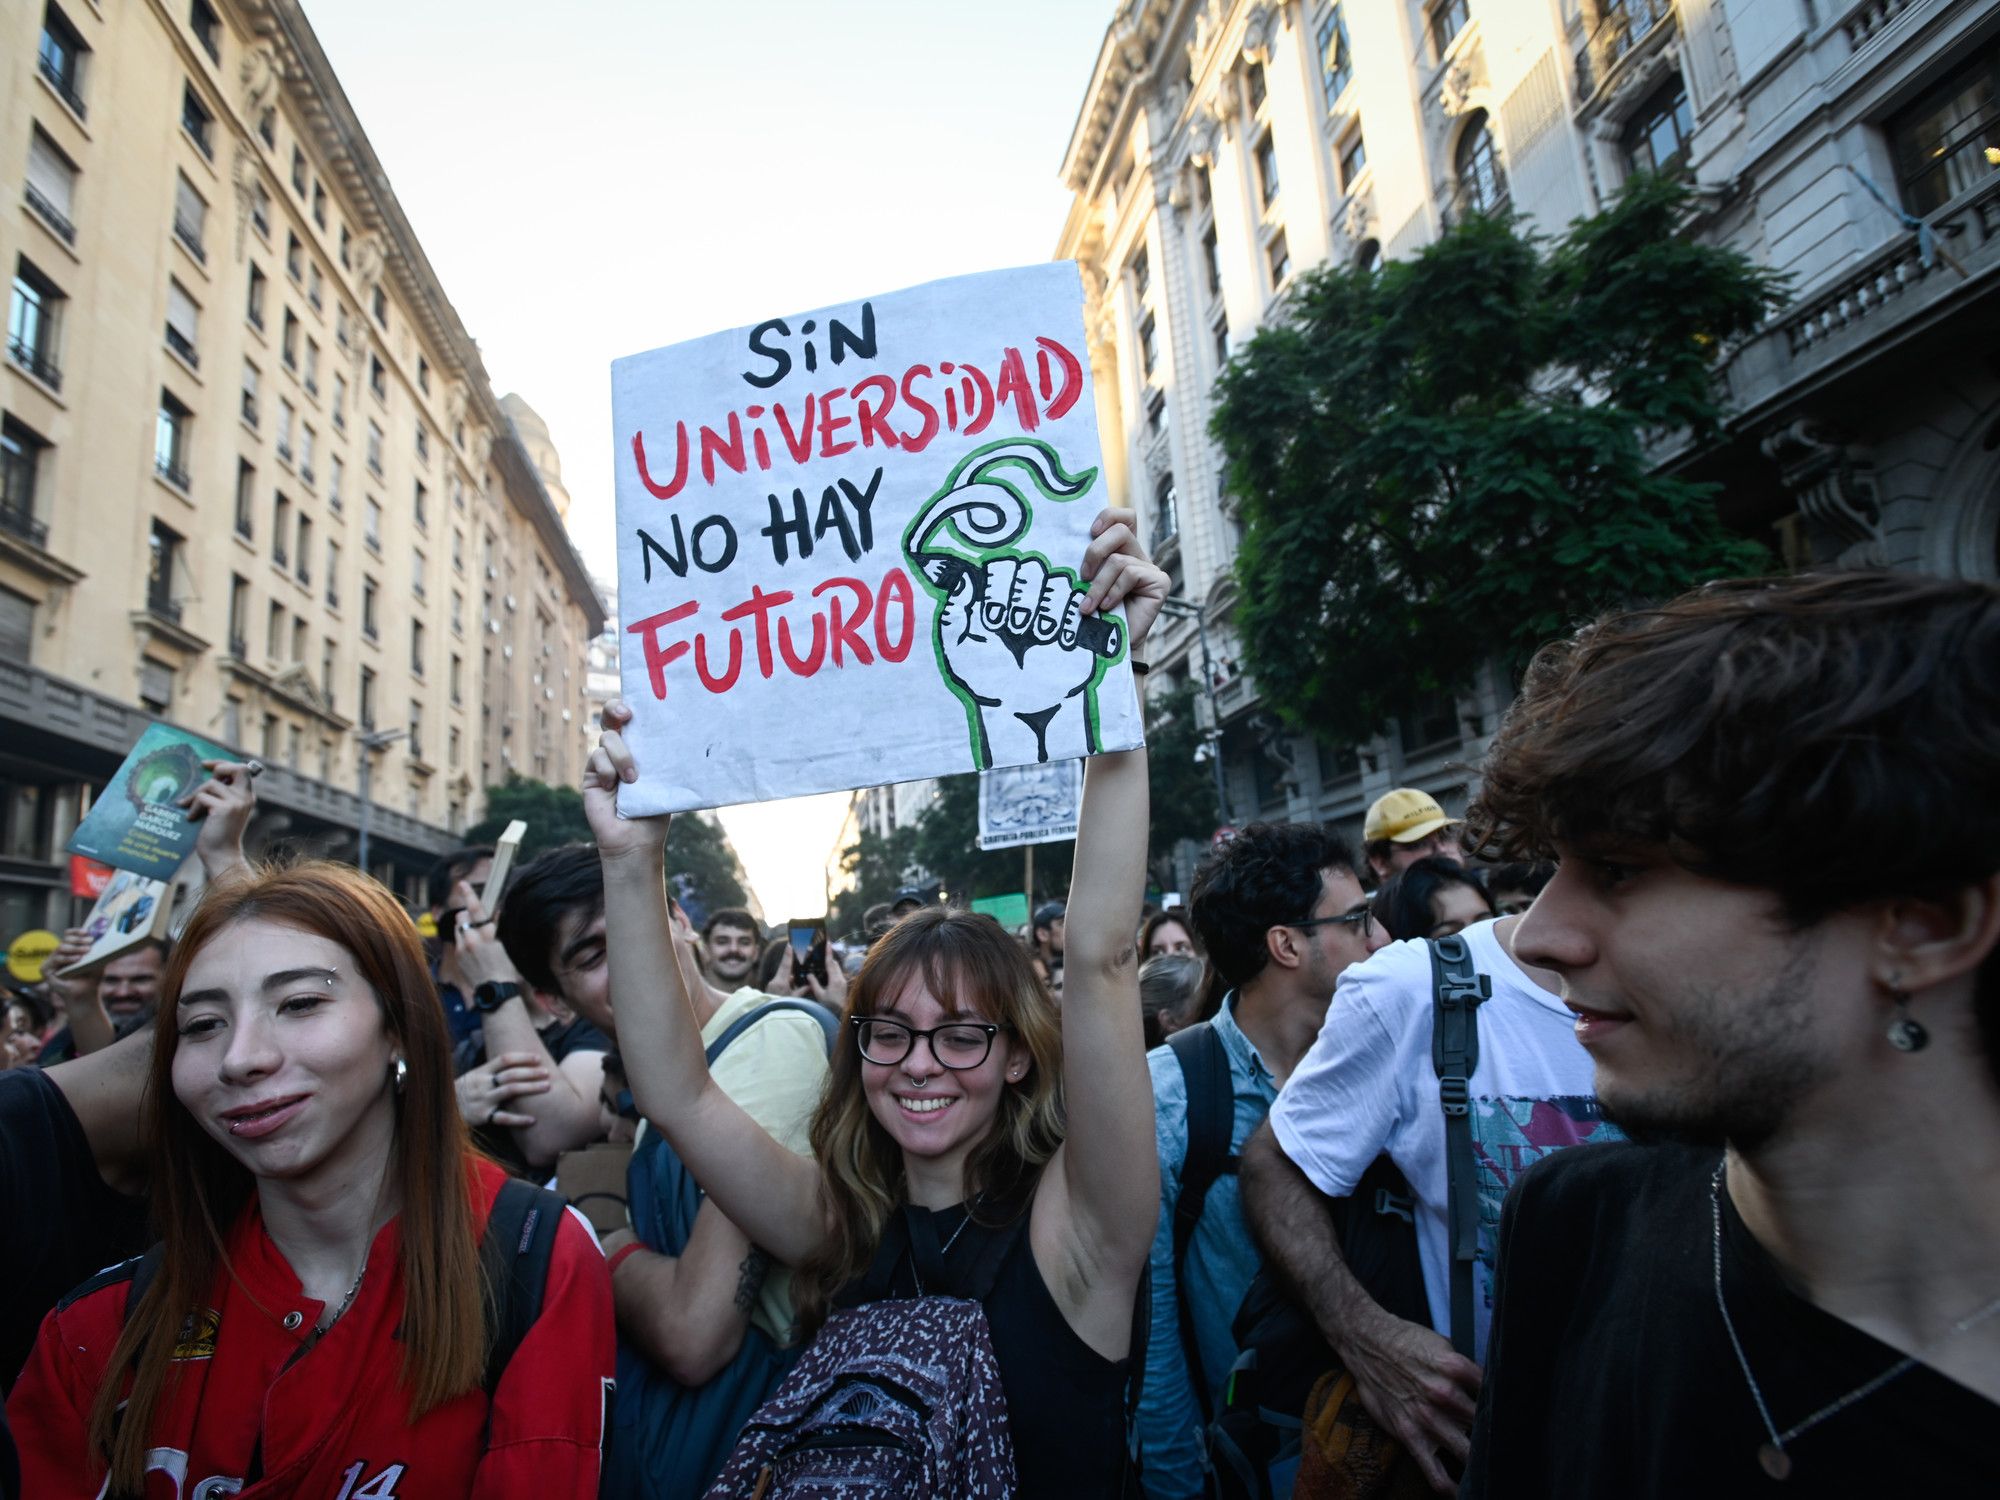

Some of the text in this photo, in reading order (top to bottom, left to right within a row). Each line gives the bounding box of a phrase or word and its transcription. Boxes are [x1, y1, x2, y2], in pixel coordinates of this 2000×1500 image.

[636, 466, 883, 584] NO HAY
[627, 567, 915, 701] FUTURO
[336, 1461, 405, 1500] 14
